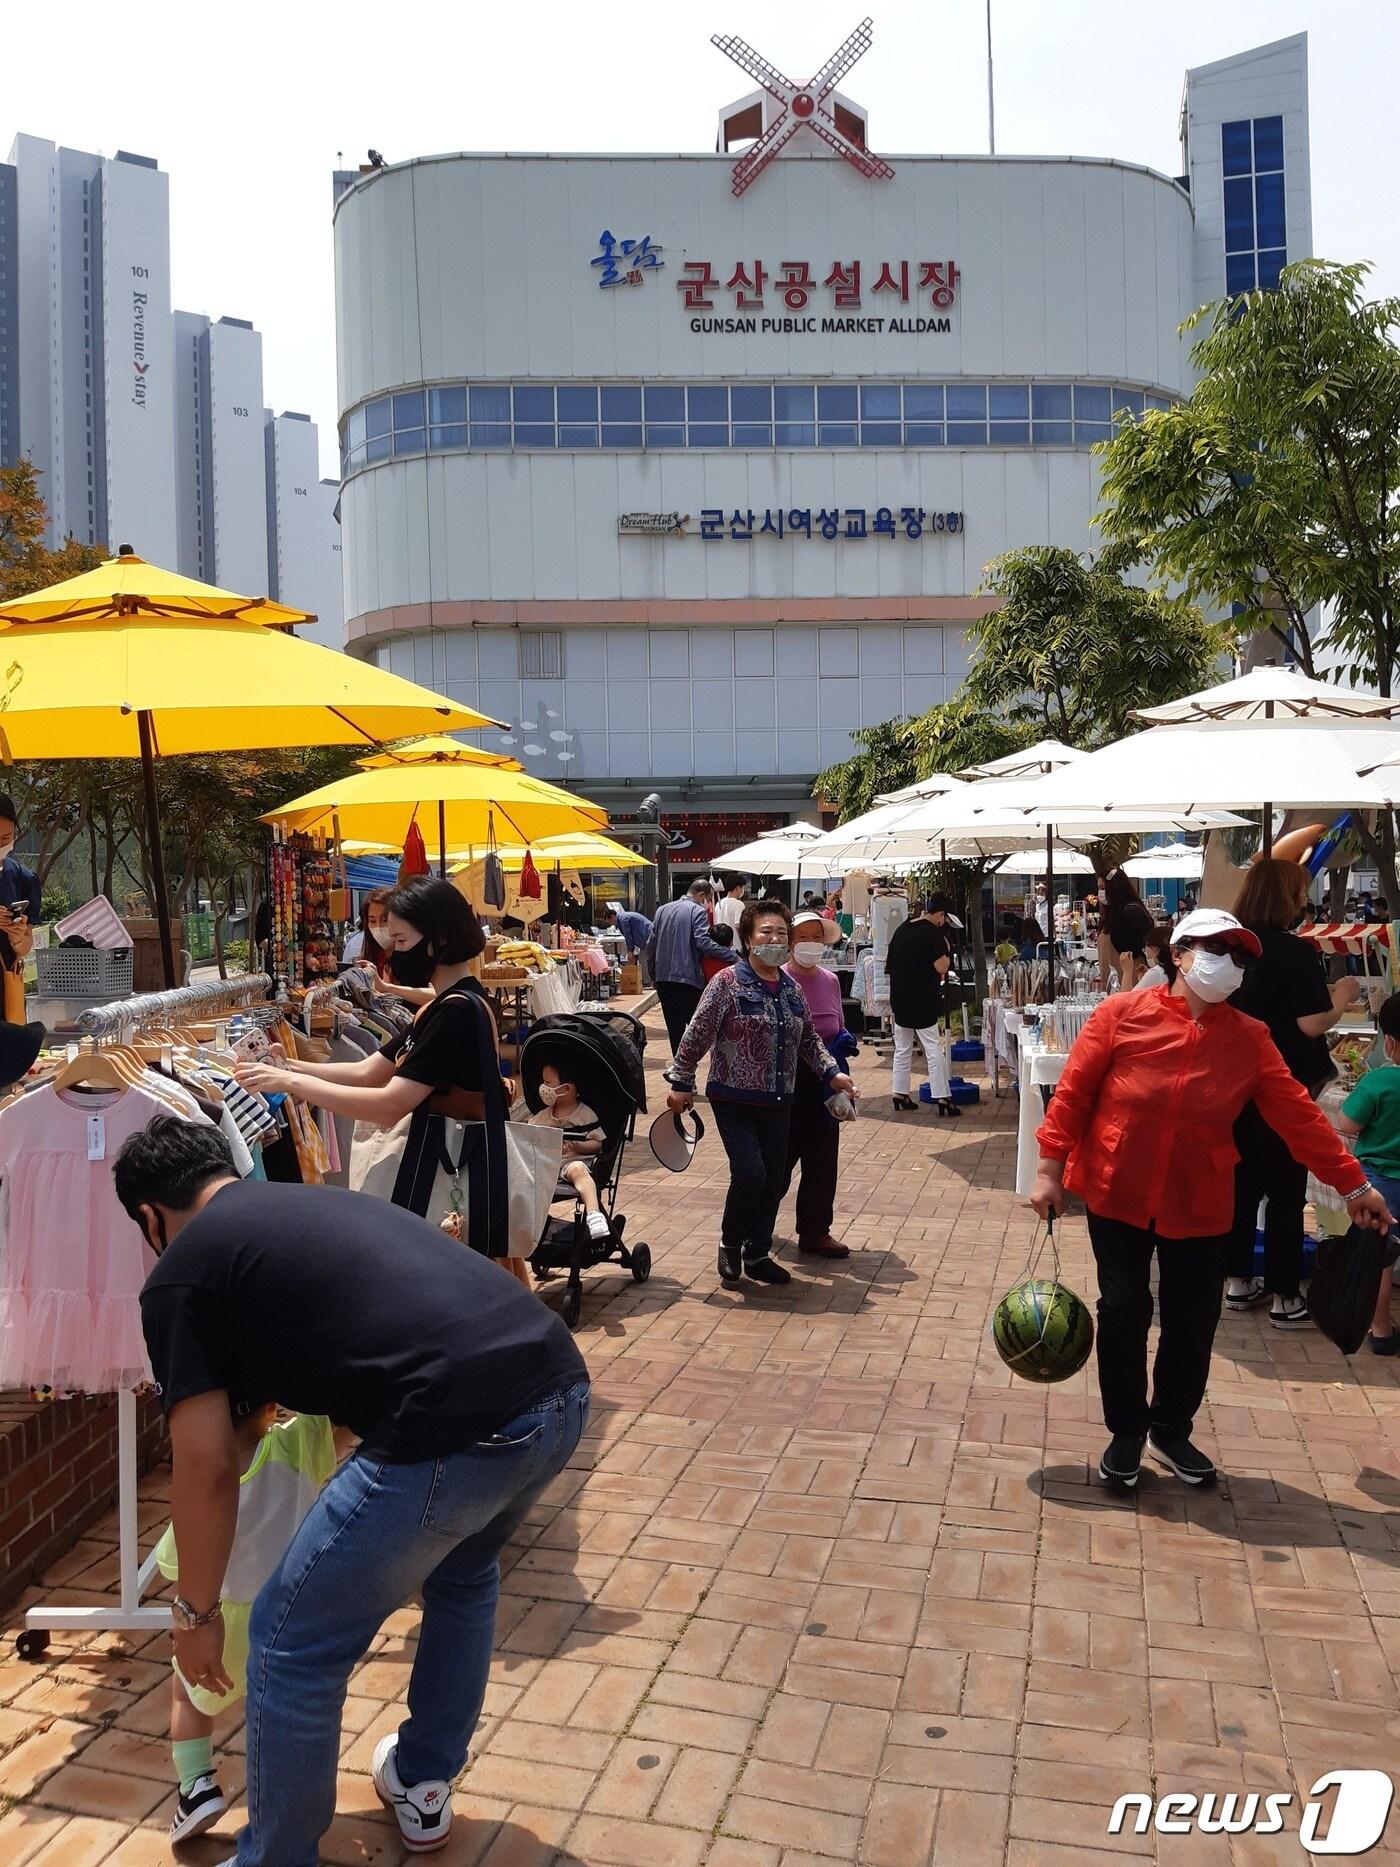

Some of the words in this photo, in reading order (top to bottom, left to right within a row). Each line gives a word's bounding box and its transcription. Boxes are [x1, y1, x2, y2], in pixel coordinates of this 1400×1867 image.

[590, 229, 665, 288] 올담
[131, 266, 149, 279] 101
[677, 260, 960, 311] 군산공설시장
[133, 291, 148, 360] Revenue
[690, 318, 756, 333] GUNSAN
[762, 318, 817, 333] PUBLIC
[821, 318, 885, 333] MARKET
[888, 318, 951, 333] ALLDAM
[233, 407, 249, 418] 103
[294, 487, 308, 497] 104
